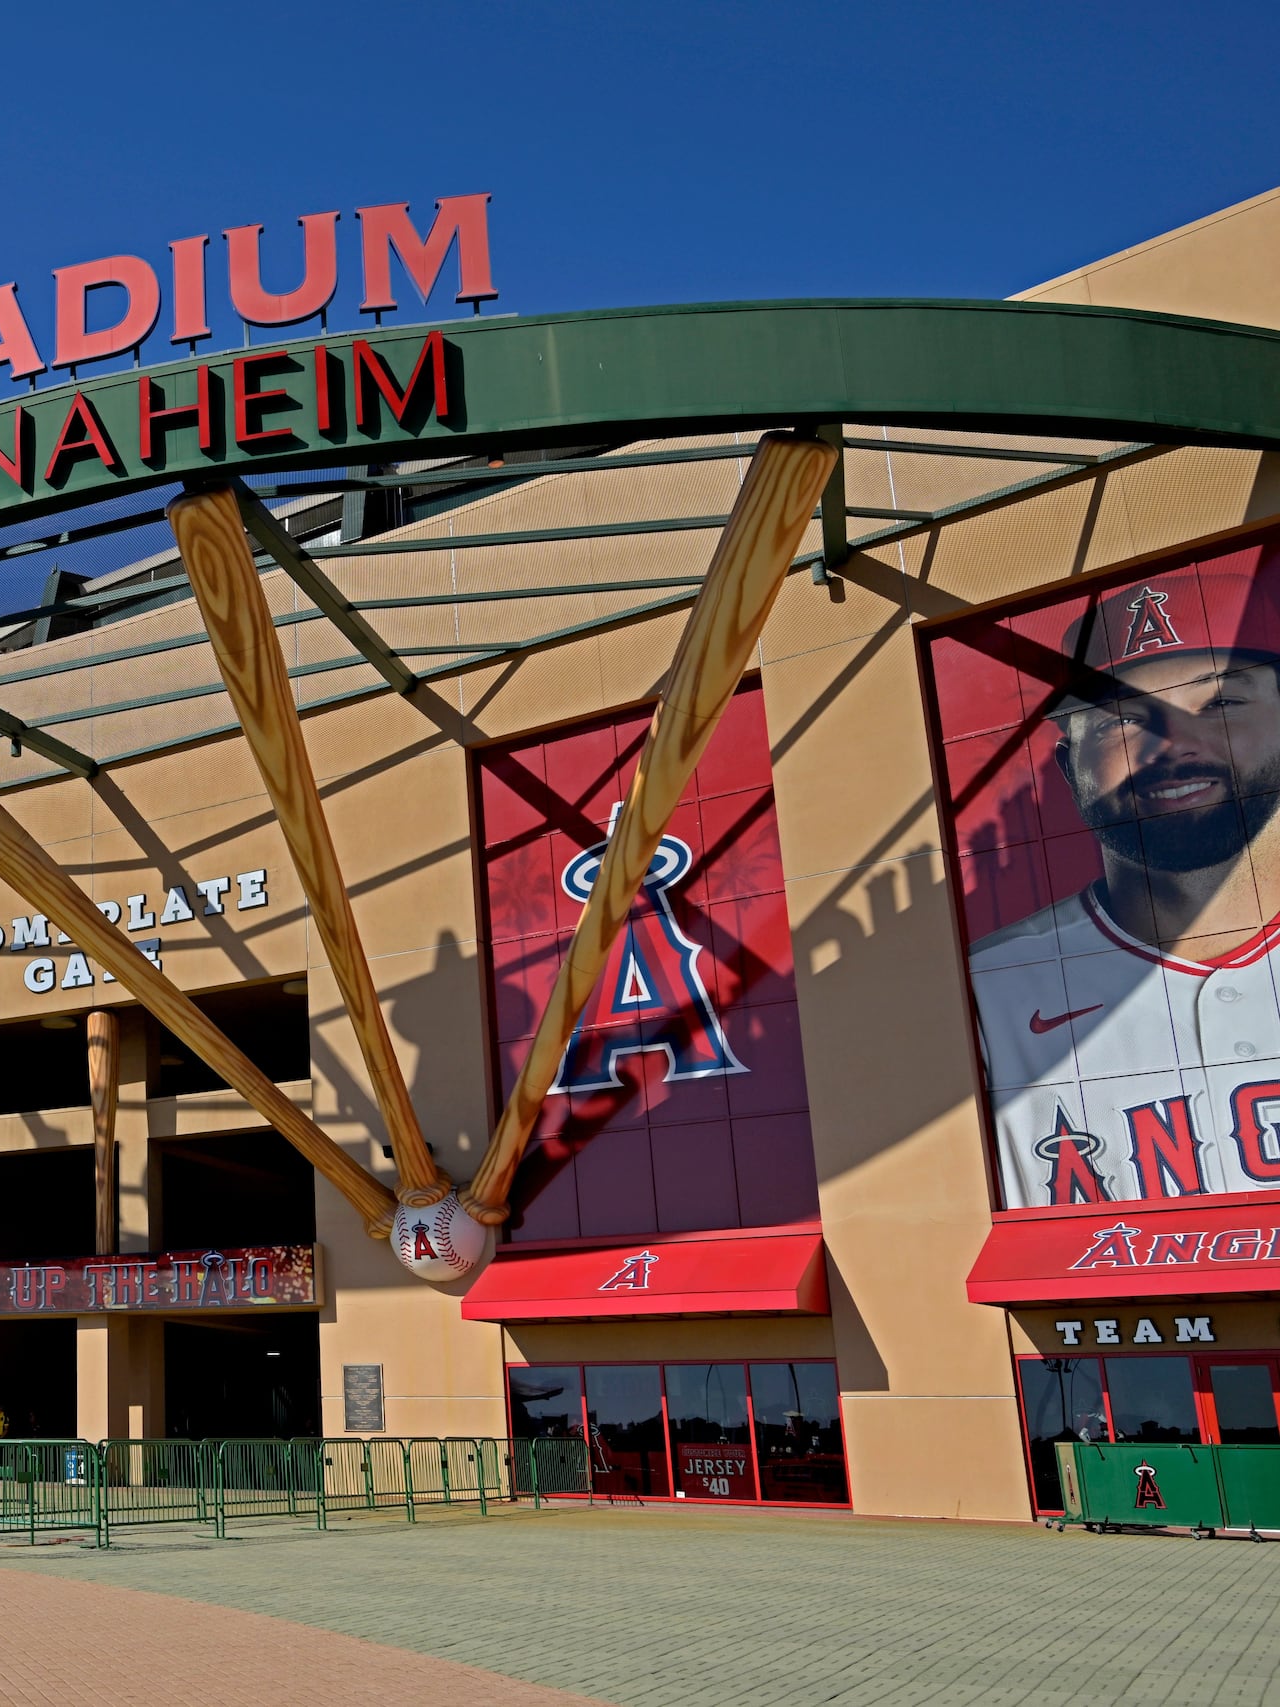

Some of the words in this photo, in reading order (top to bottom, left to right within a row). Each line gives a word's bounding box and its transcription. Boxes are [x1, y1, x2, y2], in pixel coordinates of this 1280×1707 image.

[10, 1266, 67, 1309] UP
[83, 1262, 159, 1306] THE
[170, 1250, 274, 1306] HALO
[1055, 1316, 1216, 1347] TEAM
[684, 1458, 746, 1476] JERSEY
